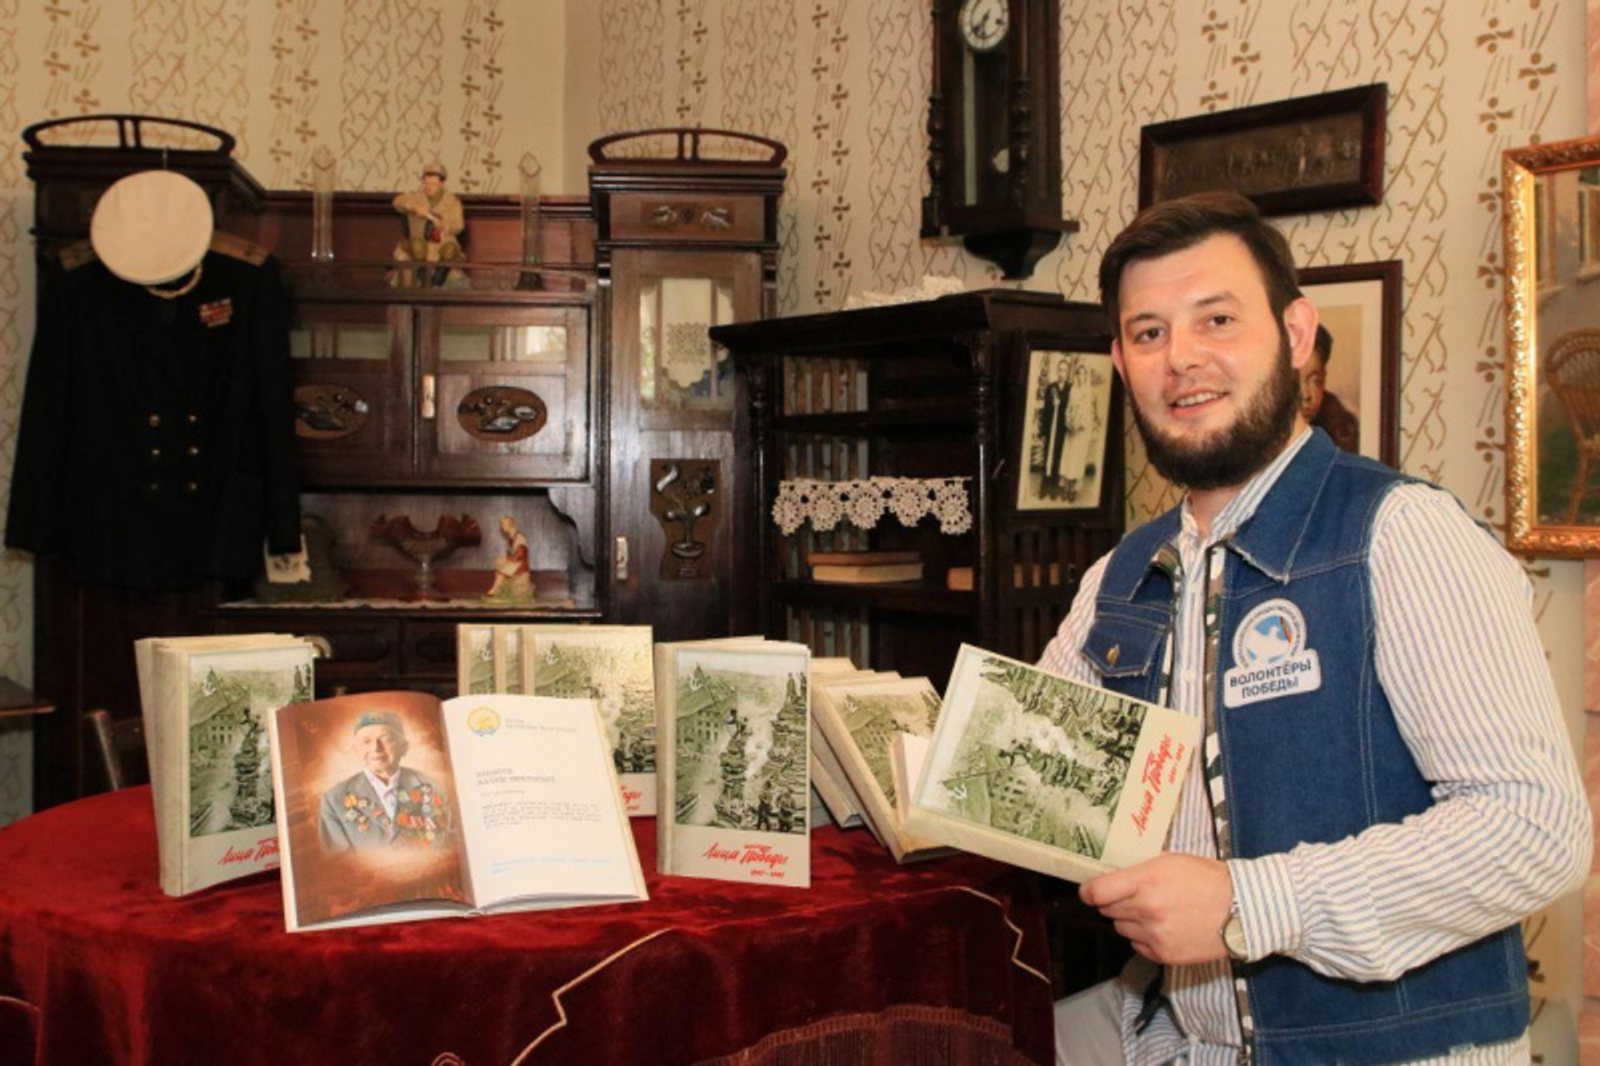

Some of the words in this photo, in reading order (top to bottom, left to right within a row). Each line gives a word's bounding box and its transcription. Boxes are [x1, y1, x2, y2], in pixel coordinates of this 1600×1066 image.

[1230, 658, 1312, 687] ВОЛОНТЁРЫ
[1242, 677, 1299, 698] ПОБЕДЫ
[740, 843, 789, 868] Победы
